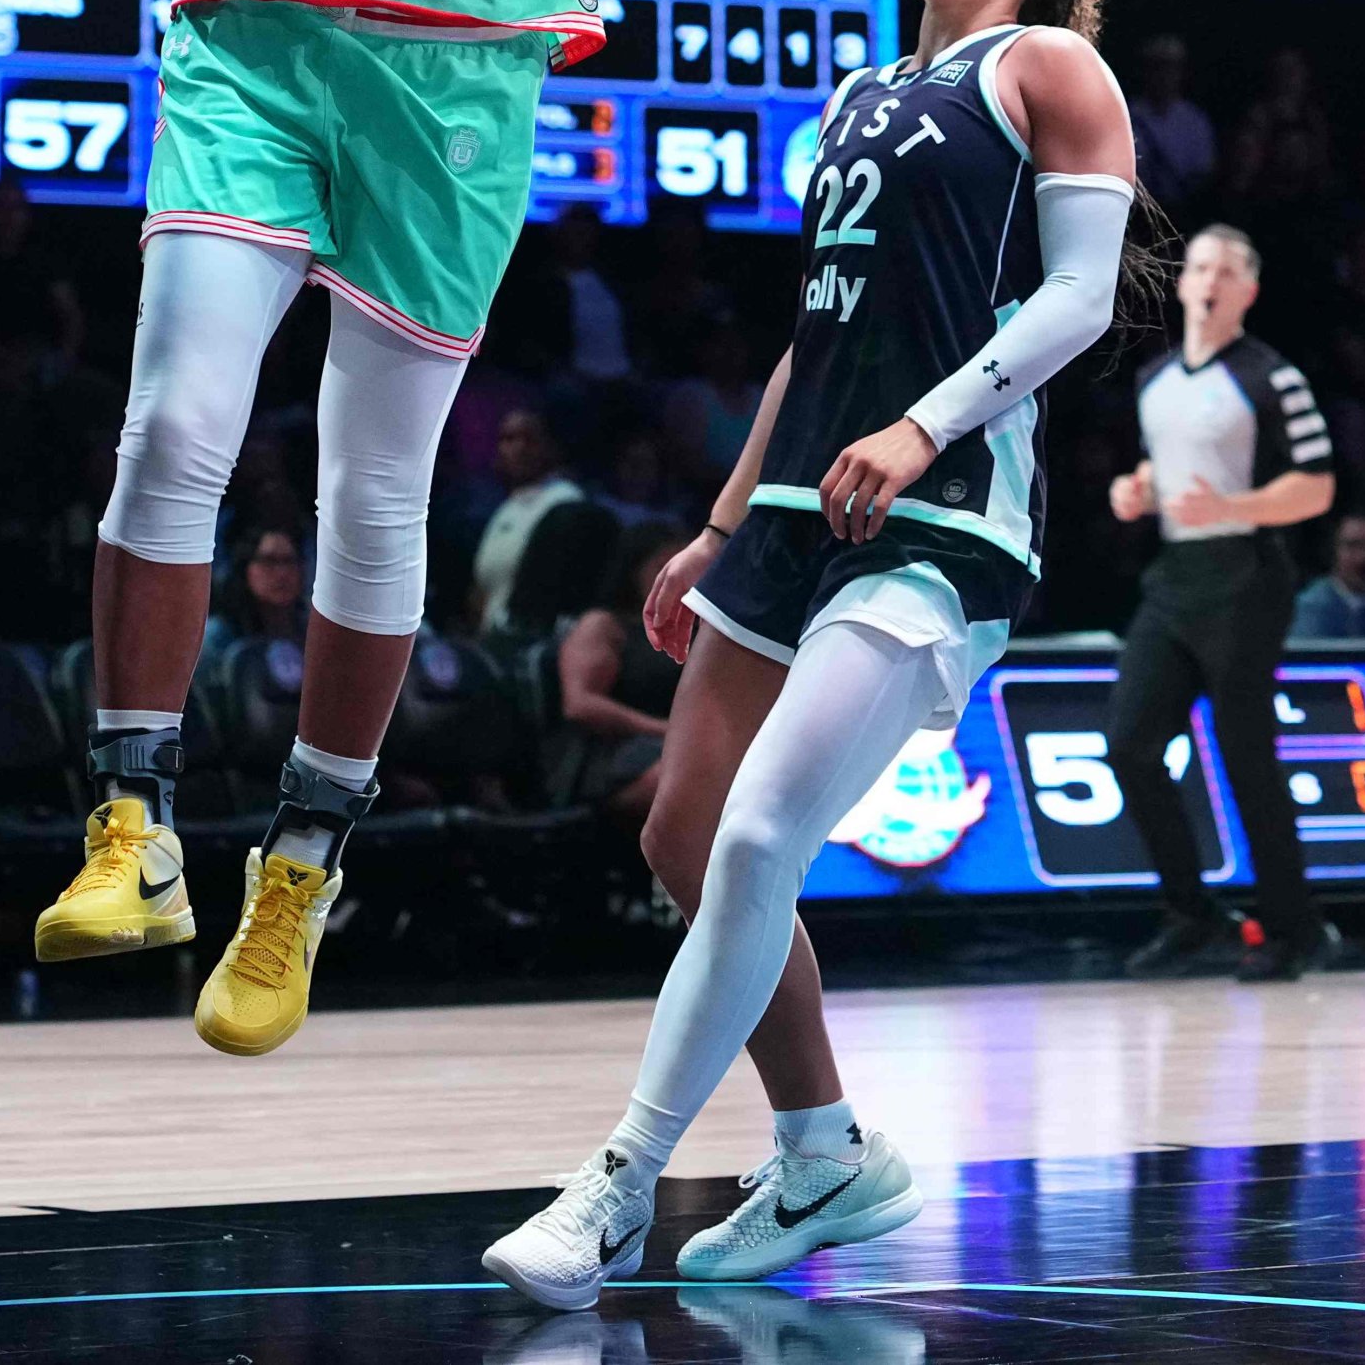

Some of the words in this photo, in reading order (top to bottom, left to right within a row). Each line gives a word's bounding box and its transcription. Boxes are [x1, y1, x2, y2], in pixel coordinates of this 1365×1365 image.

[674, 23, 709, 62] 7
[785, 31, 810, 67] 1
[3, 99, 128, 173] 57
[655, 126, 748, 197] 51
[815, 158, 882, 250] 22
[806, 264, 867, 323] ally
